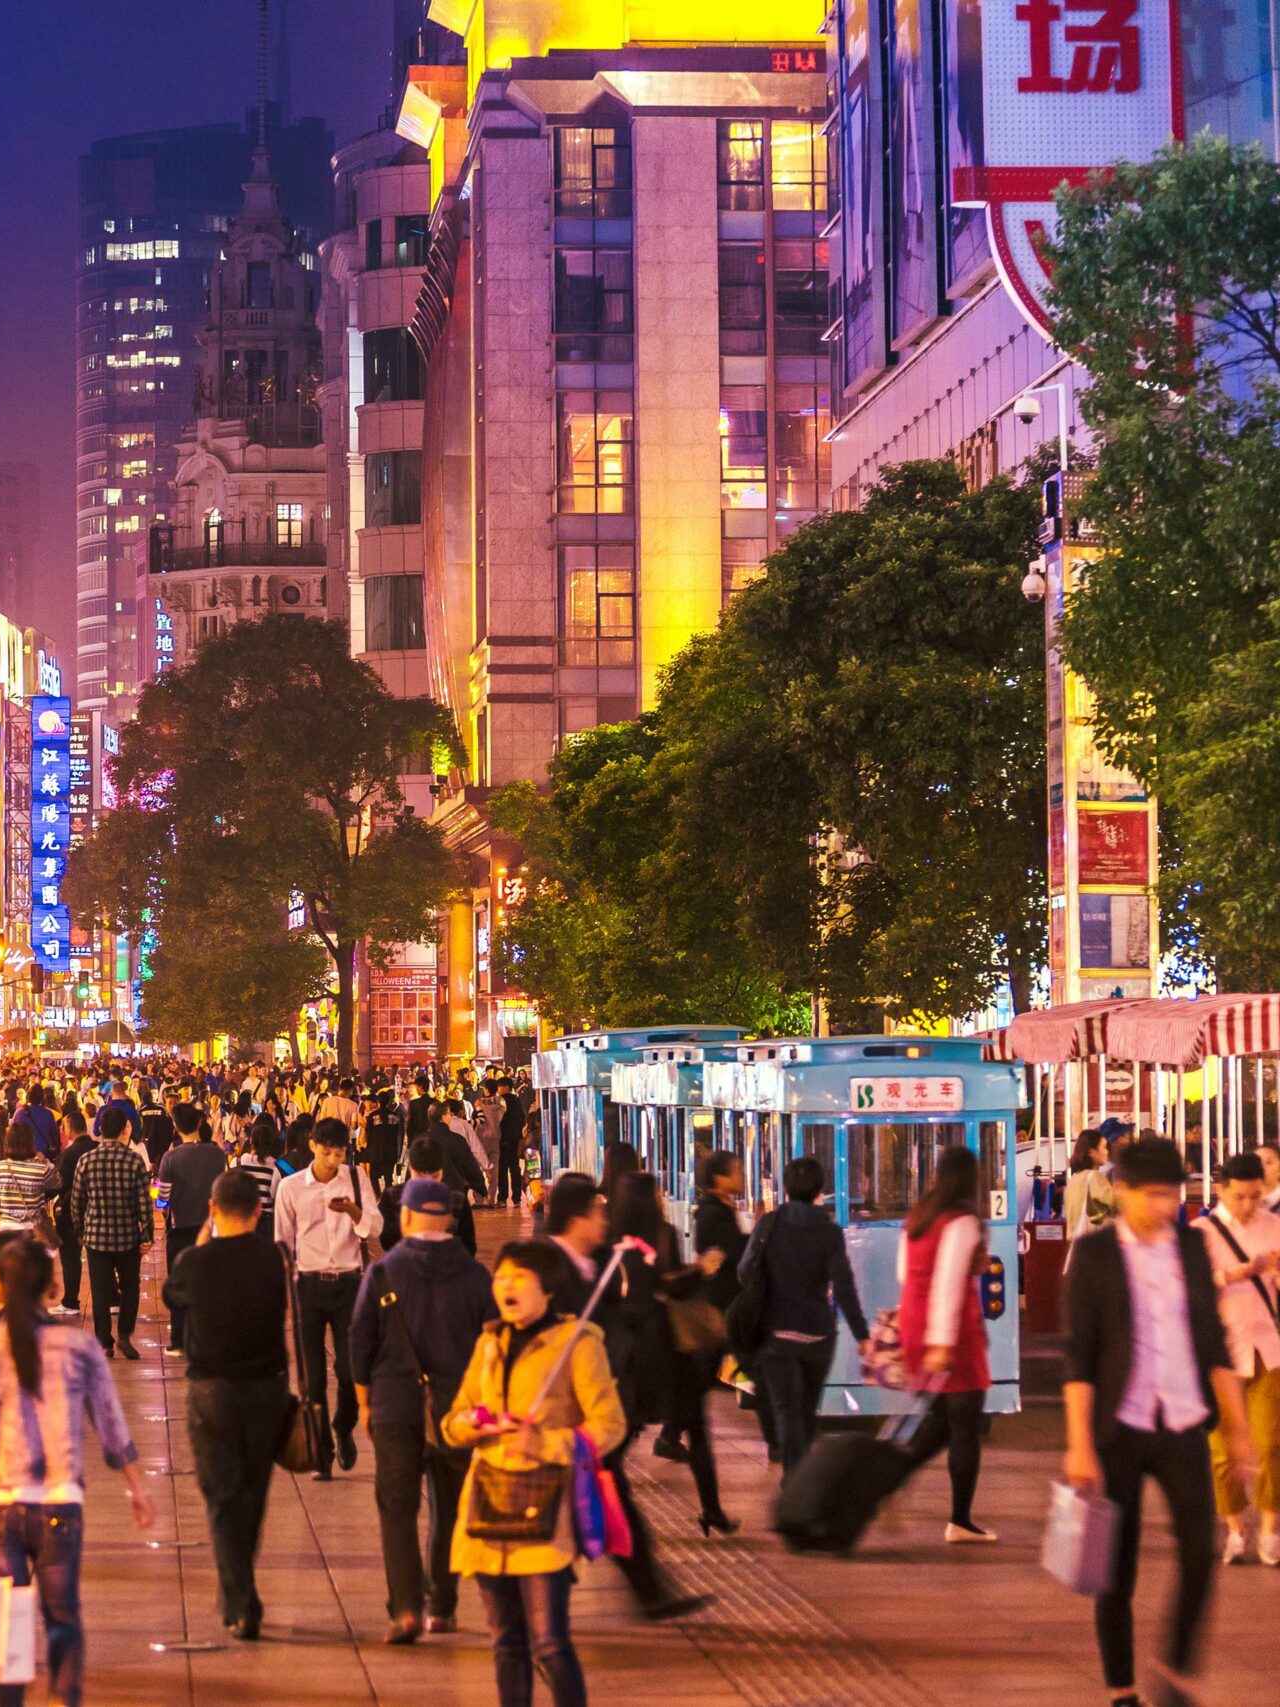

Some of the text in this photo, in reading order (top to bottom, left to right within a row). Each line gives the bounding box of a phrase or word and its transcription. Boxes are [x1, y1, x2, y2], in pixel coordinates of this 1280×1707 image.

[886, 1082, 954, 1098] 观光车
[995, 1195, 1003, 1216] 2
